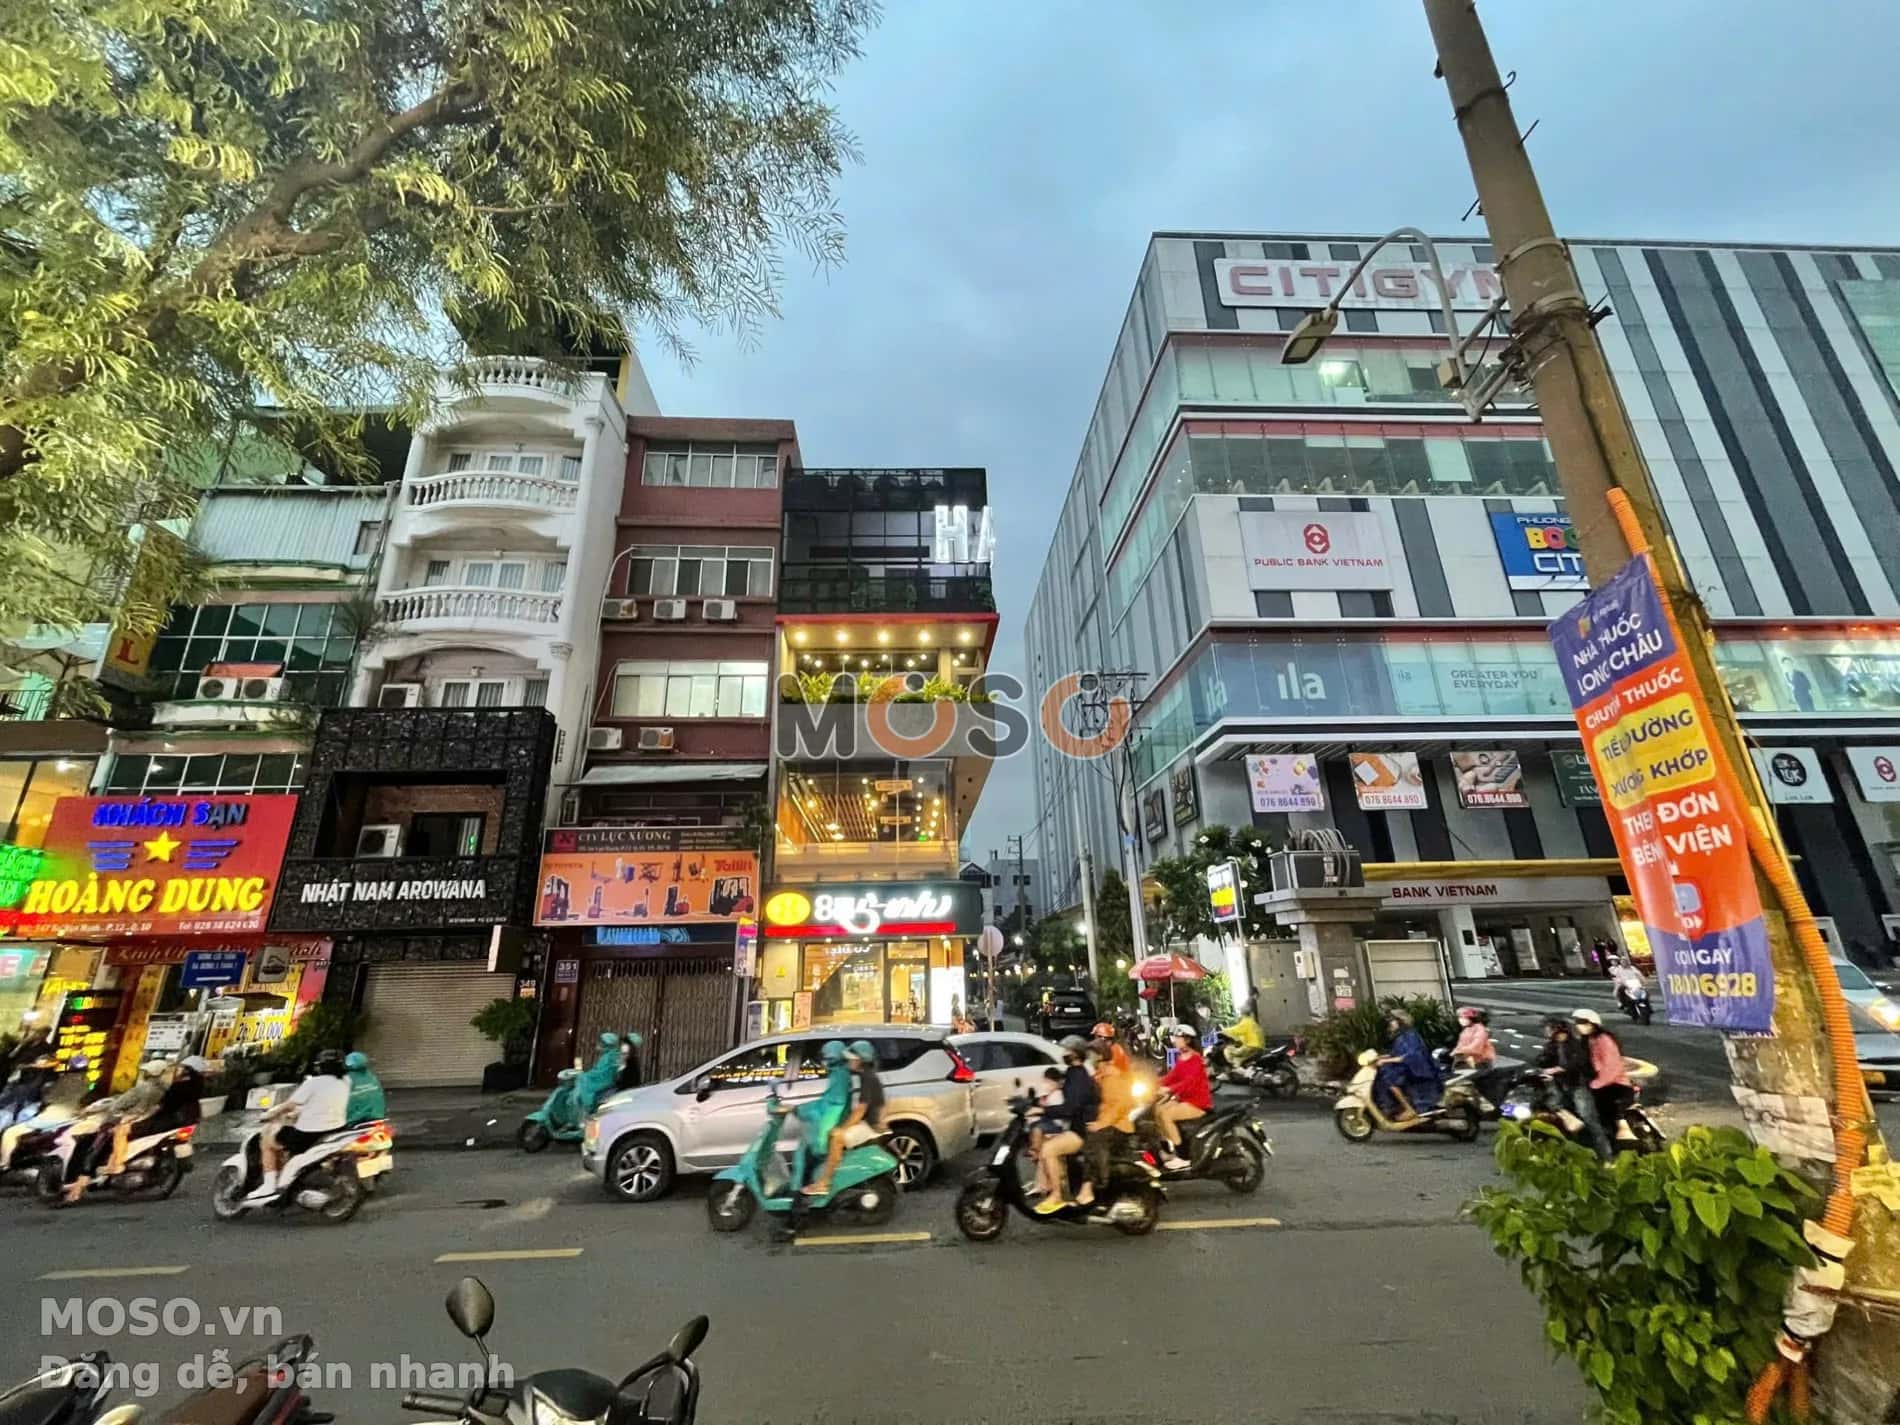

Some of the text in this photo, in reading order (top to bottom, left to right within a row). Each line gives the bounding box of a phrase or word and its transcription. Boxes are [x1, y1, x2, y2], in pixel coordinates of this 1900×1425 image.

[1525, 526, 1580, 550] BOO
[1254, 557, 1384, 568] PUBLIC BANK VIETNAM
[1533, 553, 1582, 573] CIT
[1609, 629, 1664, 672] CHÂU
[1278, 662, 1326, 700] ila
[1450, 670, 1537, 680] GREATER YOU
[1453, 680, 1520, 689] EVERYDAY
[1622, 667, 1684, 705] THUỐC
[1649, 748, 1709, 780] KHỚP
[93, 797, 248, 830] KHÁCH SẠN
[1656, 791, 1720, 824] ĐƠN
[1664, 823, 1733, 856] VIỆN
[157, 877, 265, 913] DUNG
[301, 879, 486, 907] NHẬT NAM AROWANA
[1392, 885, 1498, 898] BANK VIETNAM
